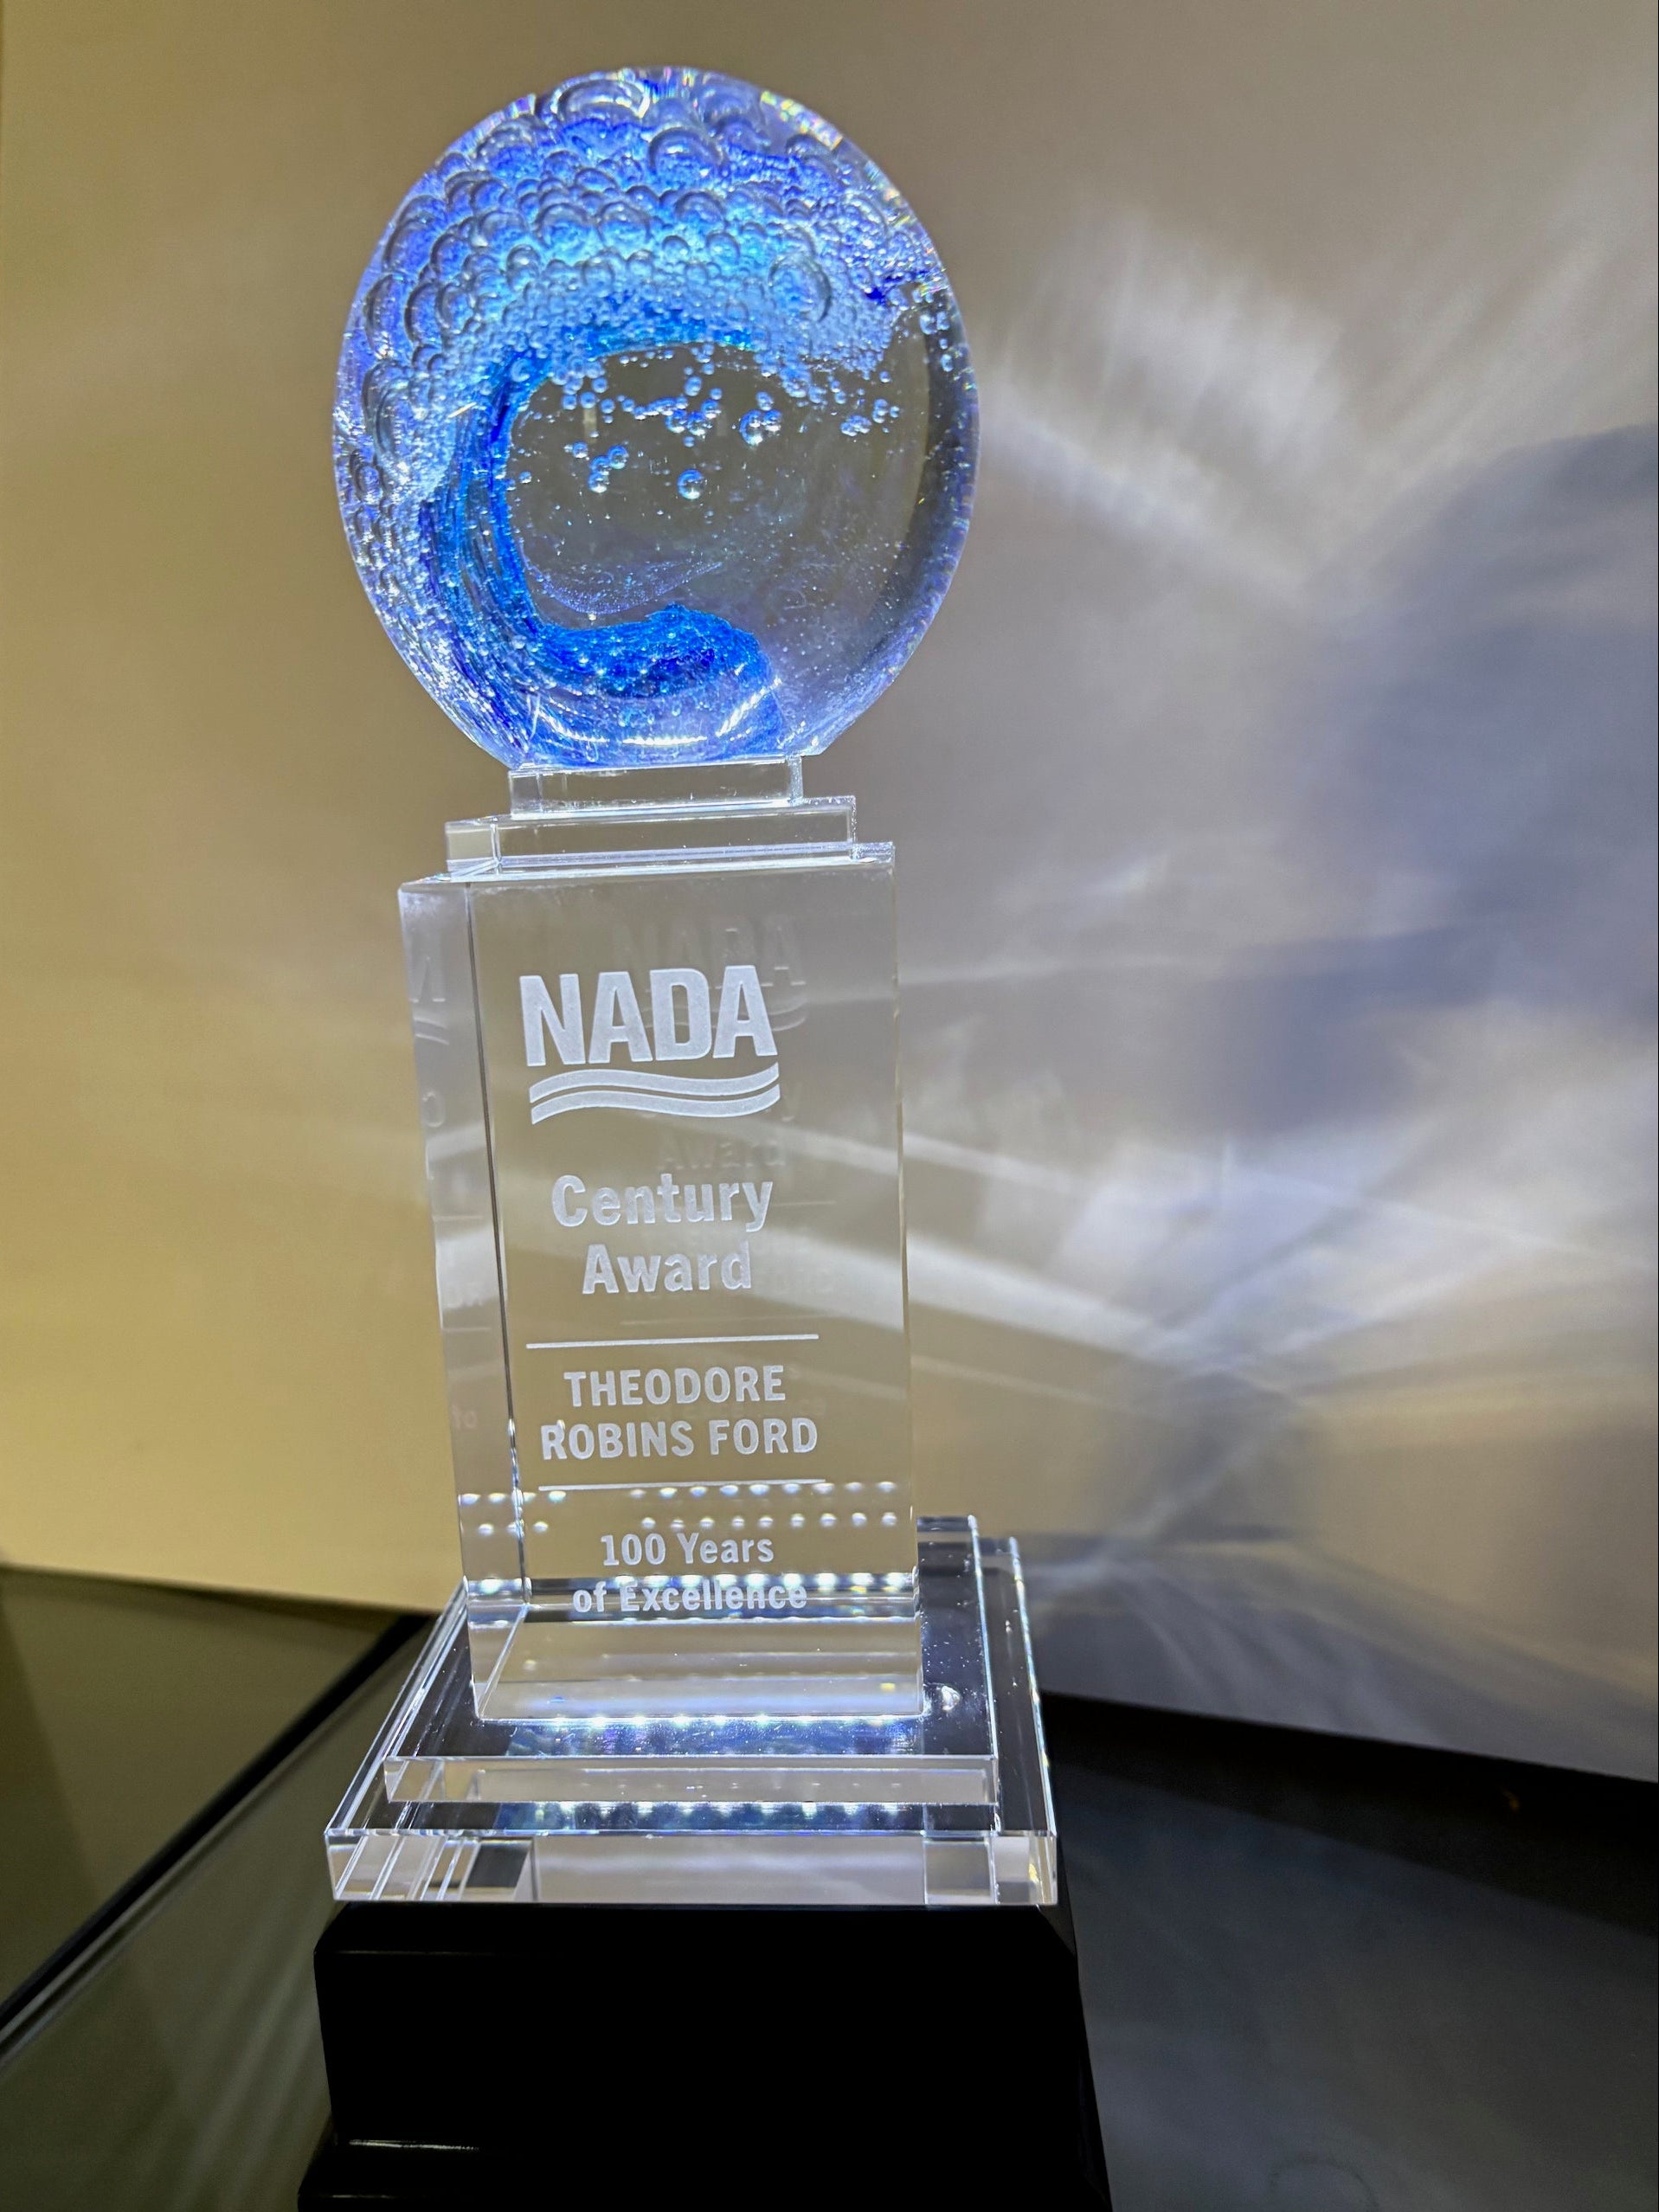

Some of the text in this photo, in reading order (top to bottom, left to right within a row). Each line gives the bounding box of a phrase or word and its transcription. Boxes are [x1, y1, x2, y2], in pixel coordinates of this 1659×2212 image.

[519, 965, 778, 1066] NADA
[552, 1173, 773, 1232] Century
[582, 1241, 752, 1295] Award
[563, 1365, 786, 1407] THEODORE
[540, 1418, 818, 1460] ROBINS FORD
[600, 1533, 774, 1566] 100 Years
[572, 1579, 807, 1613] of Excellence
